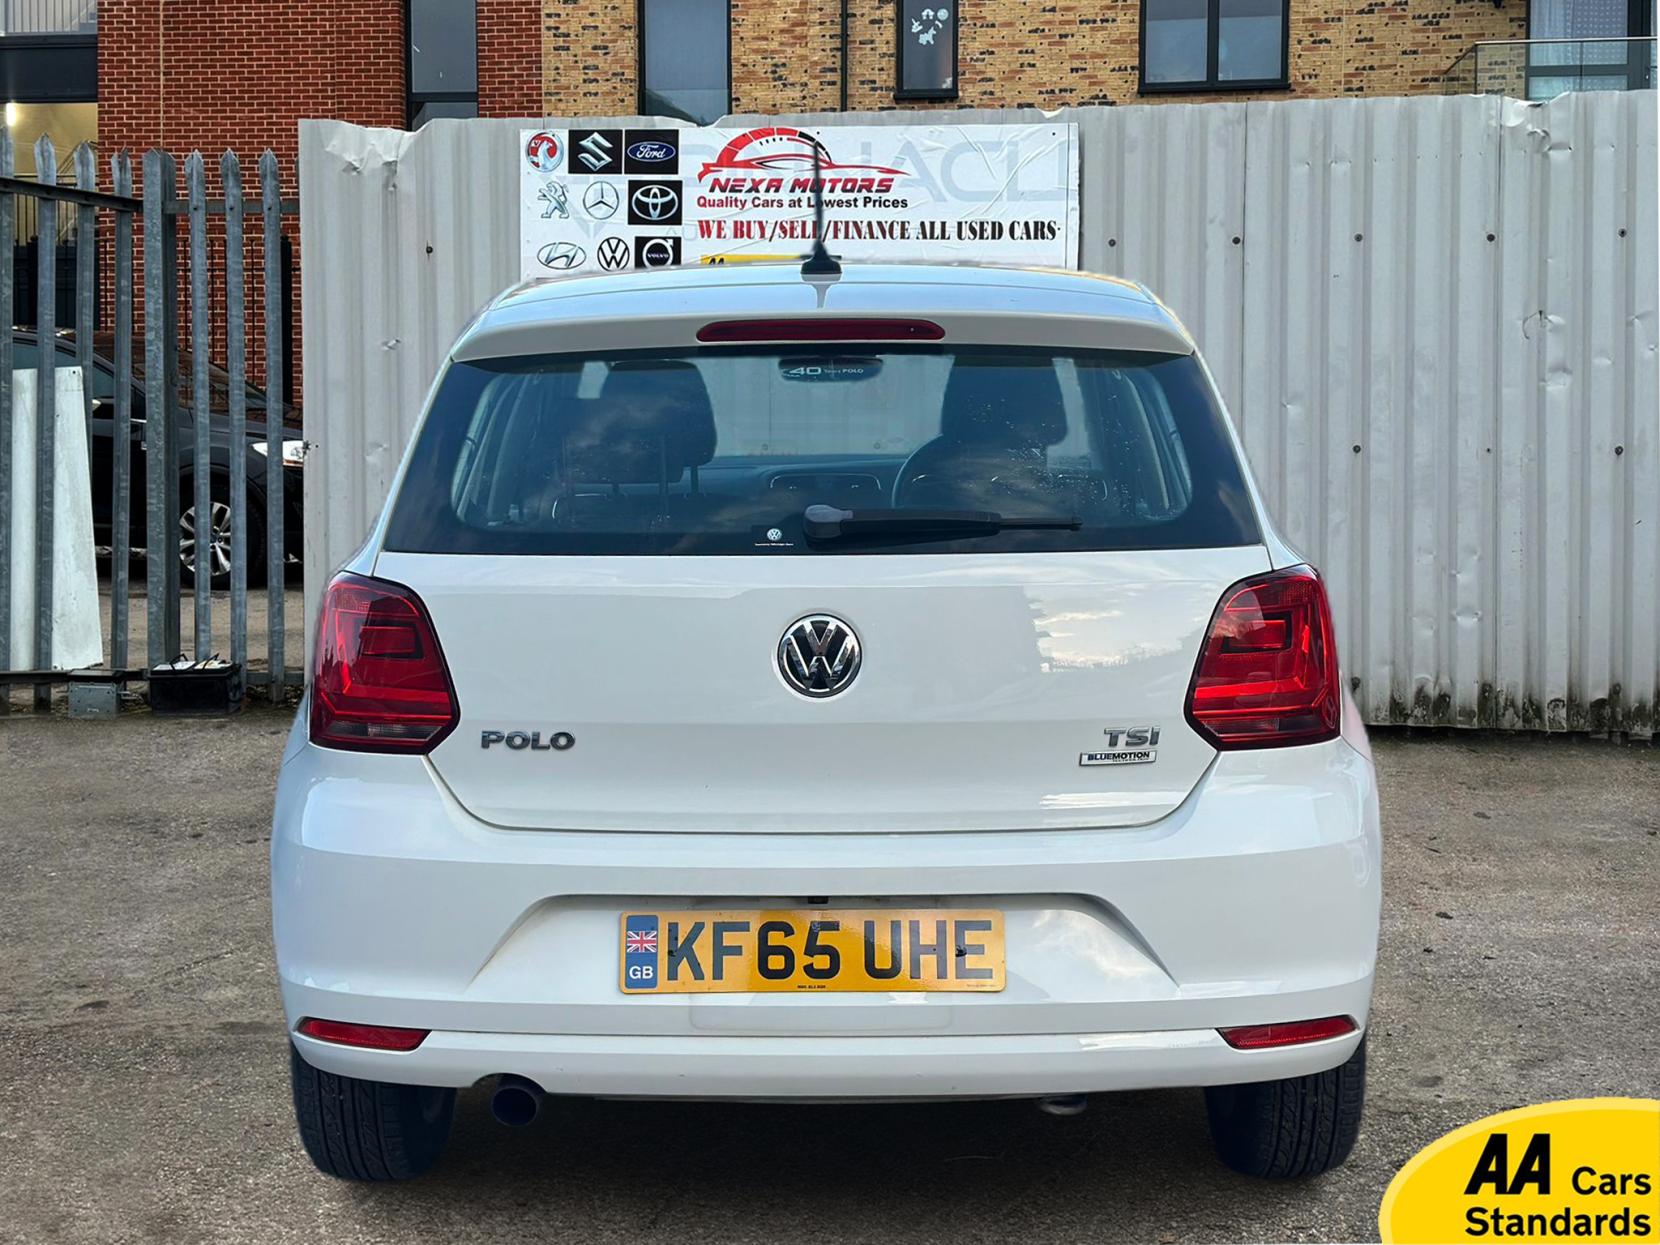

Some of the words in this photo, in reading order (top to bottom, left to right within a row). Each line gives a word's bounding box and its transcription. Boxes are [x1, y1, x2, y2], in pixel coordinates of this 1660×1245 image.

[636, 144, 666, 158] Ford
[709, 177, 784, 193] NEXA
[789, 177, 895, 193] MOTORS
[697, 195, 747, 210] Quality
[752, 196, 784, 208] Cars
[788, 197, 803, 208] at
[863, 196, 908, 208] Prices
[698, 219, 727, 239] WE
[916, 220, 951, 240] ALL
[956, 220, 1004, 241] USED
[481, 730, 576, 751] POLO
[1103, 726, 1160, 748] TSI
[1087, 751, 1150, 761] BLUEMOTION
[667, 920, 841, 980] KF65
[863, 920, 993, 980] UHE
[629, 966, 653, 979] GB
